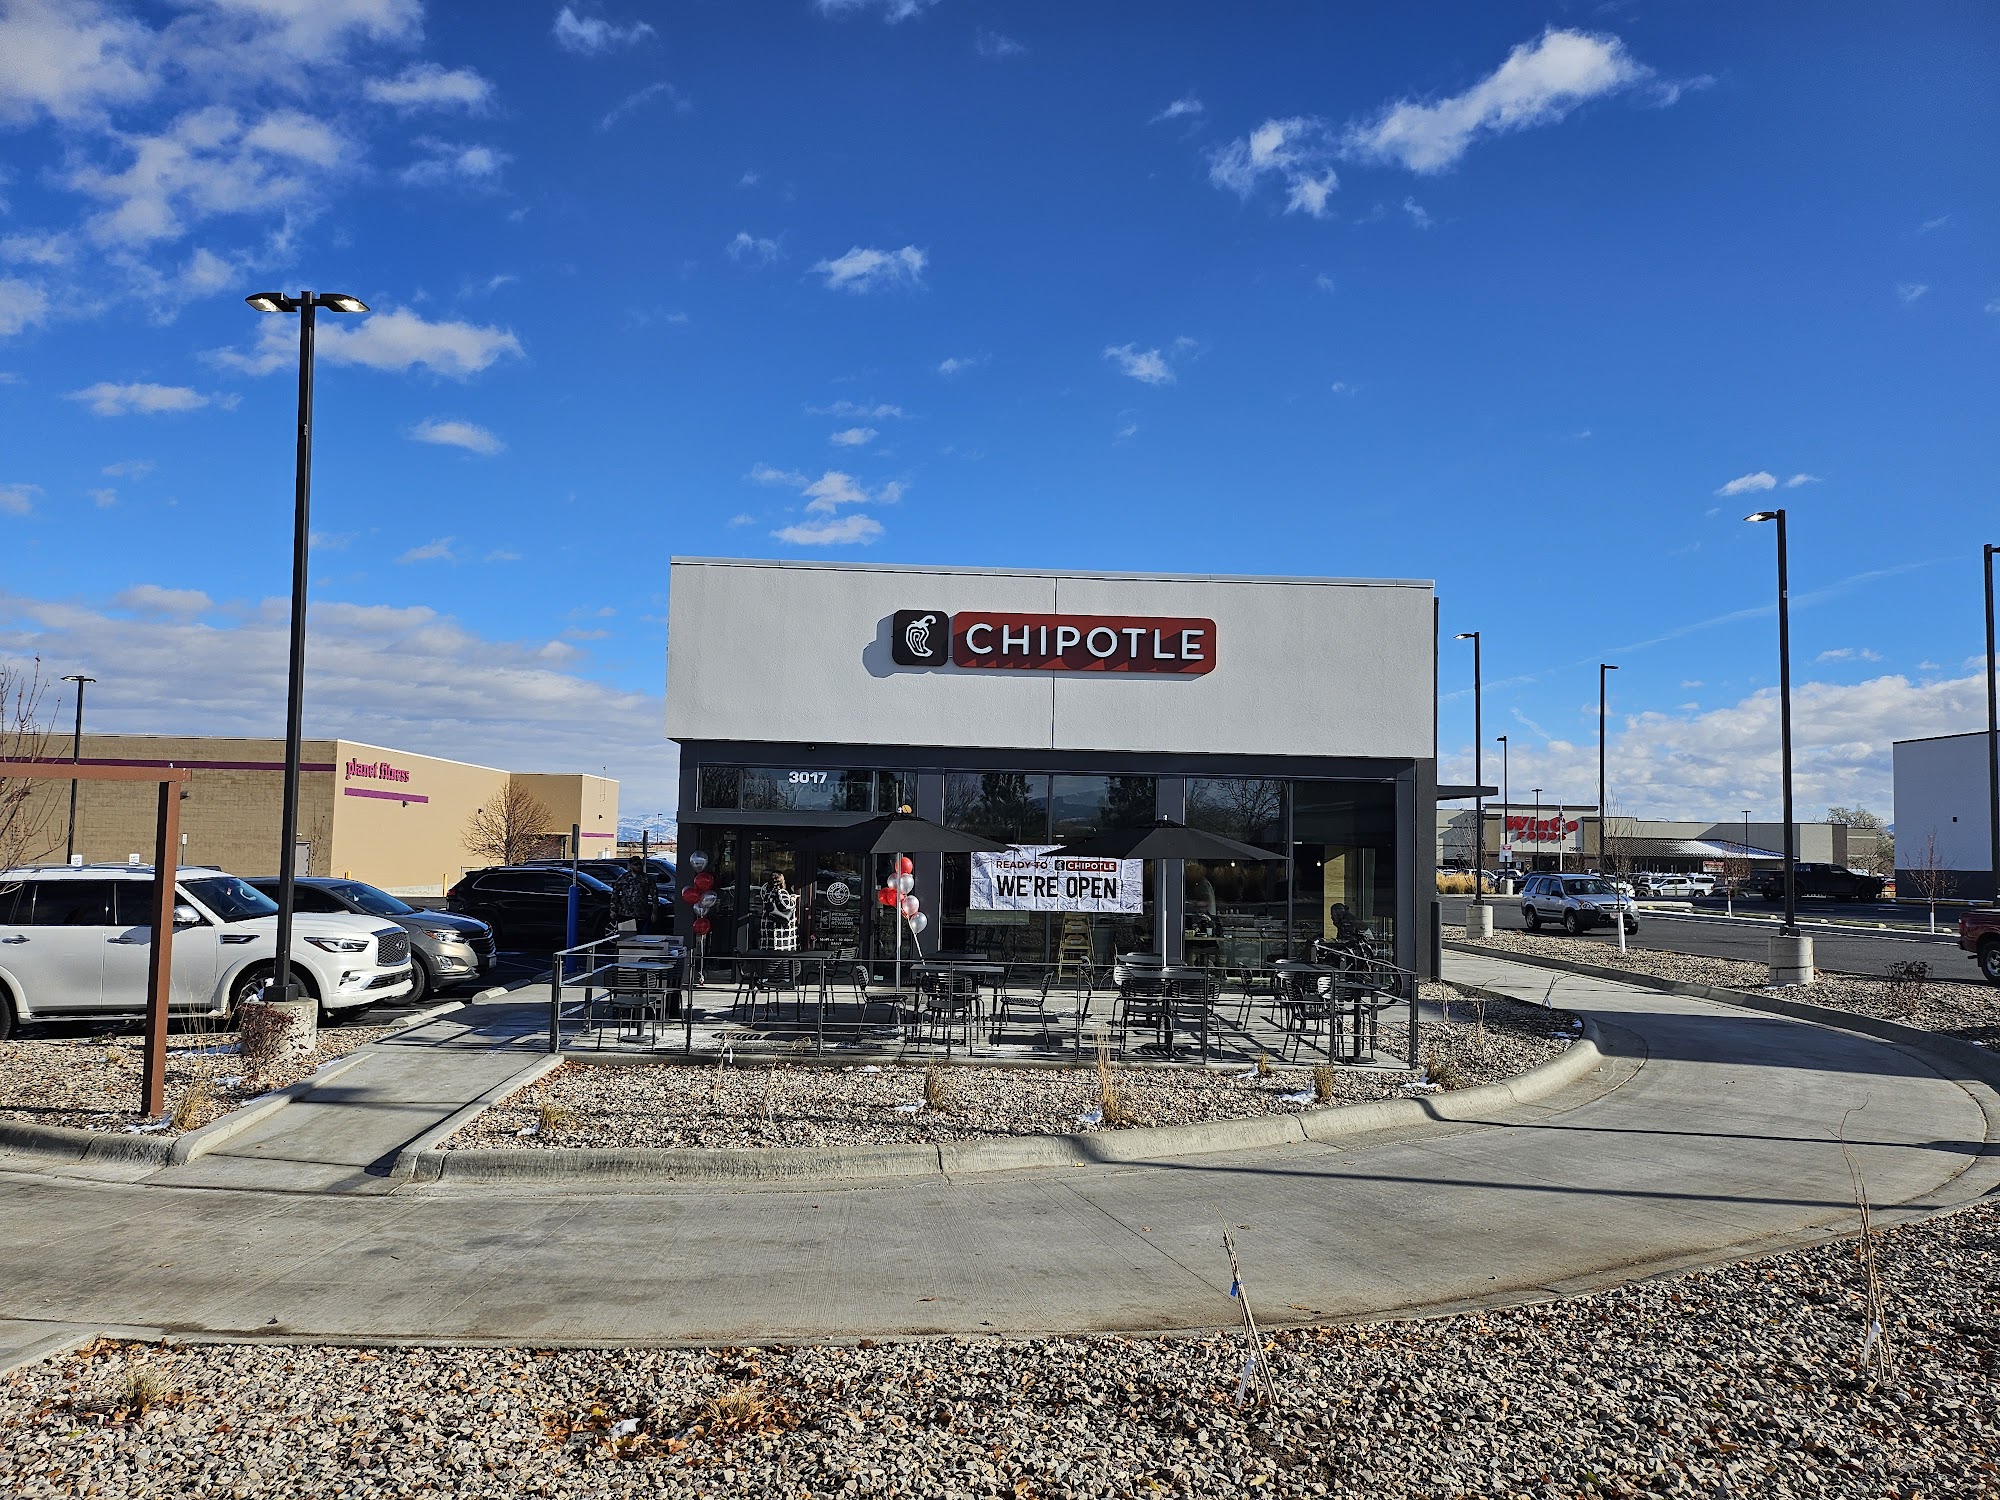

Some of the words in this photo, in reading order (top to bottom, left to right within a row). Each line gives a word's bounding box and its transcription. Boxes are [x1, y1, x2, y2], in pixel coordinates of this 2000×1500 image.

[965, 623, 1205, 660] CHIPOTLE
[345, 758, 378, 780] planet
[379, 762, 410, 782] fitness
[788, 771, 828, 784] 3017
[996, 861, 1031, 869] READY
[1034, 861, 1048, 869] TO
[1067, 862, 1116, 871] CHIPOTLE
[996, 875, 1058, 897] WE'RE
[1066, 877, 1117, 899] OPEN
